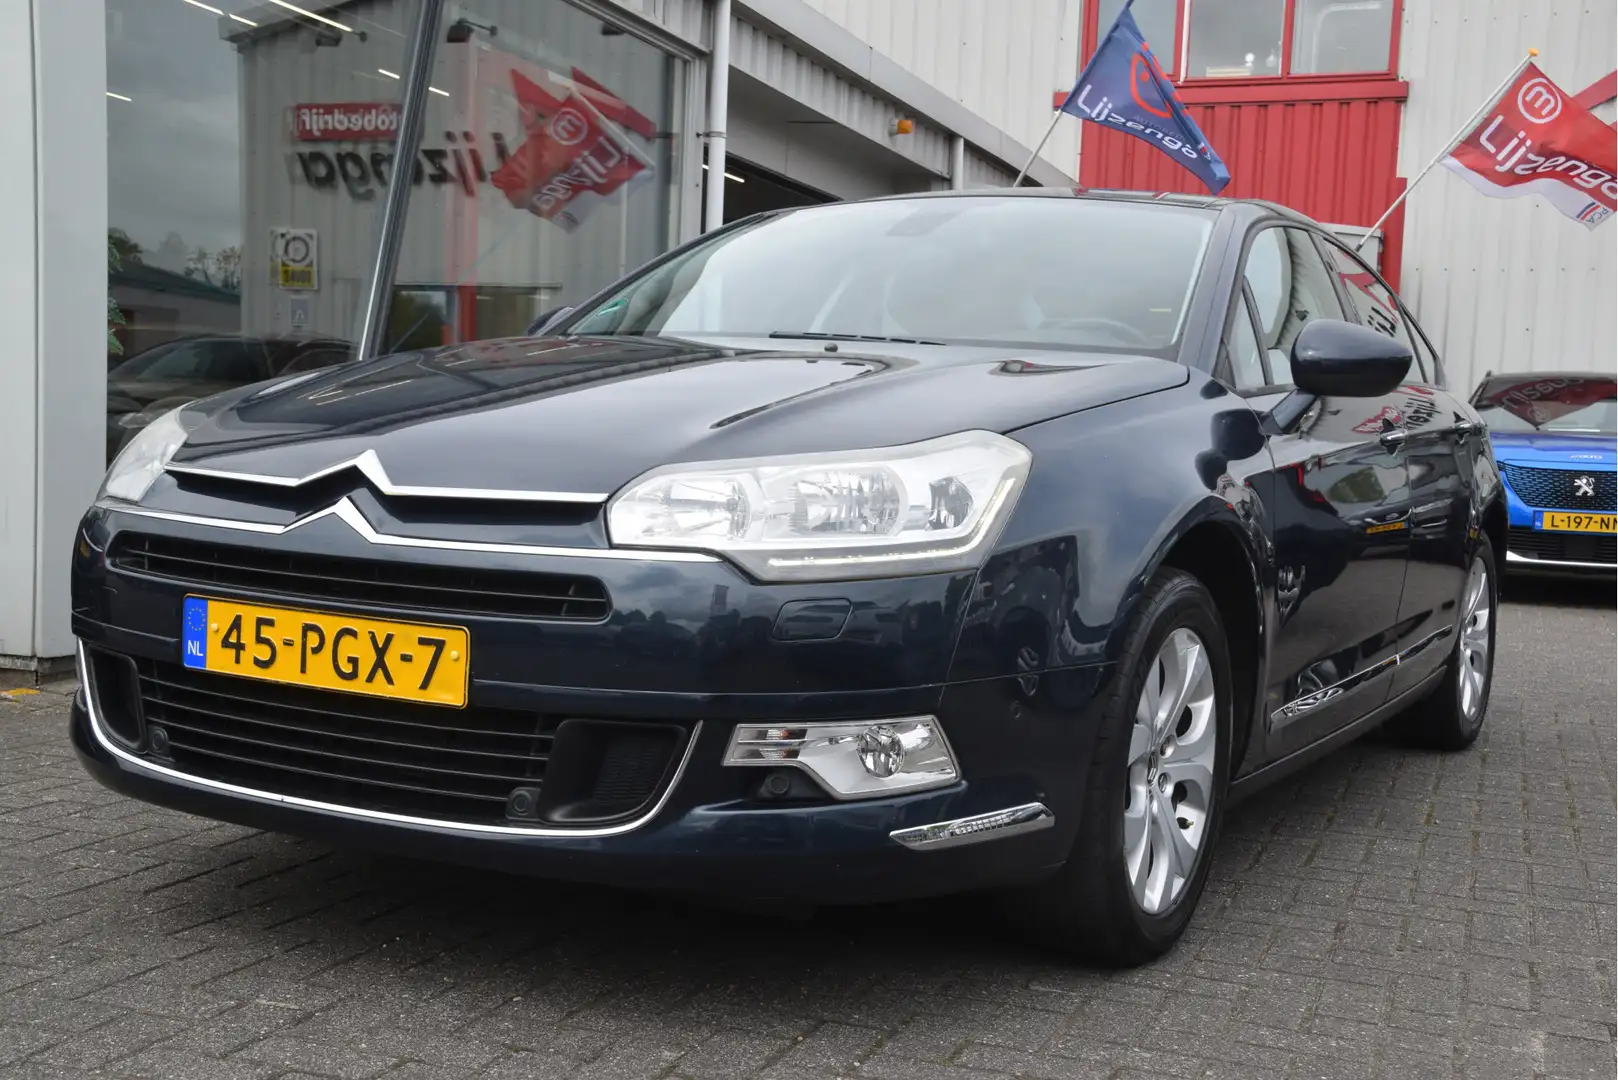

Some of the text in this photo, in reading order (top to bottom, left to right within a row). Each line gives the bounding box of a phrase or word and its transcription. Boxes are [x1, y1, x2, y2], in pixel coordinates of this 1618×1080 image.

[1077, 84, 1198, 159] Lijzenga
[187, 612, 446, 691] NL 45-PGX-7
